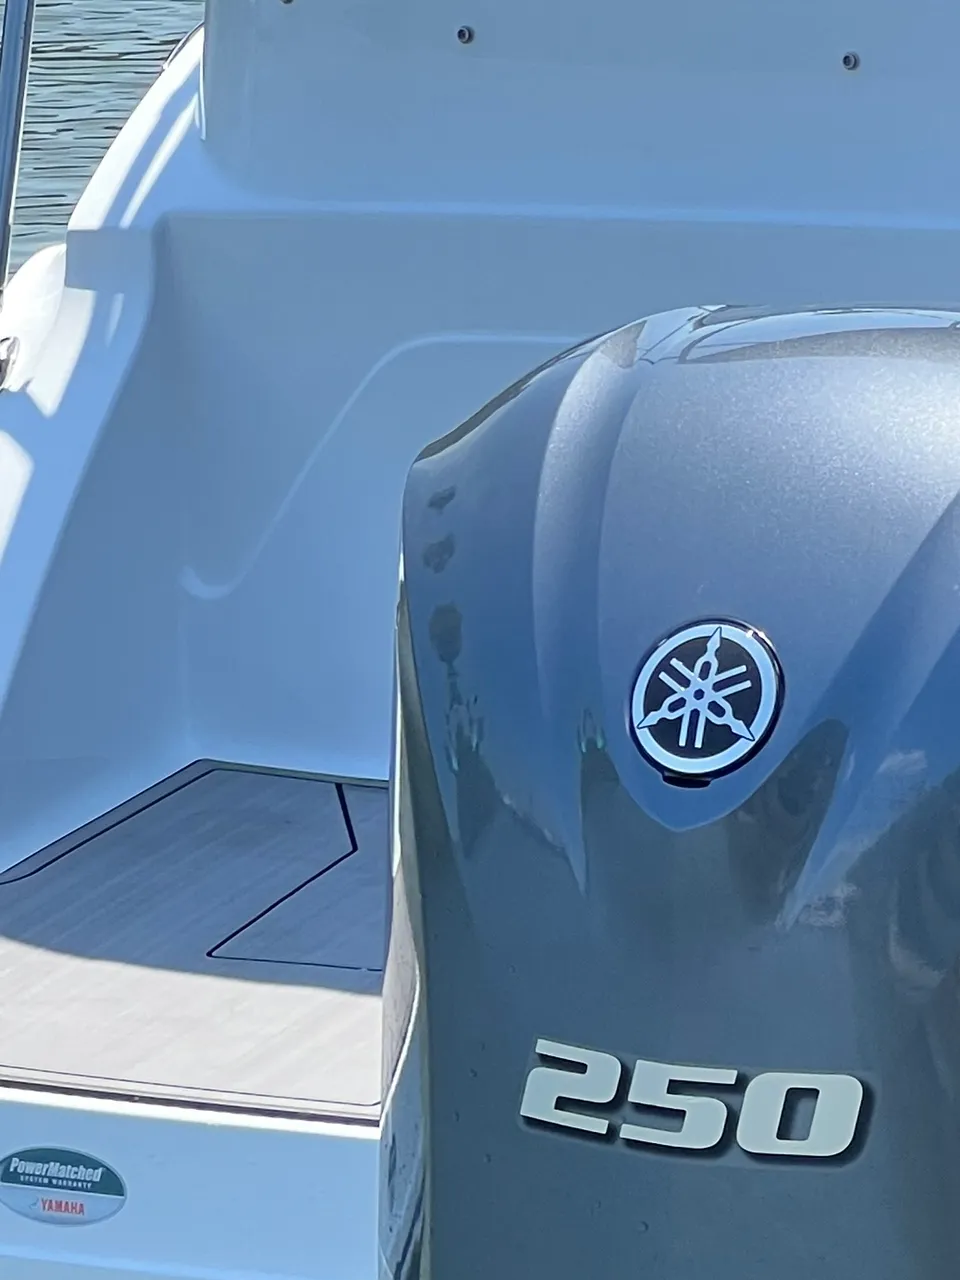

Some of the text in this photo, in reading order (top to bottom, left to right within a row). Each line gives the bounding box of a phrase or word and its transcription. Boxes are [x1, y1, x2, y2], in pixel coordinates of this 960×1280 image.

[520, 1038, 864, 1157] 250
[9, 1157, 104, 1182] PowerMatched
[41, 1198, 85, 1216] YAMAHA
